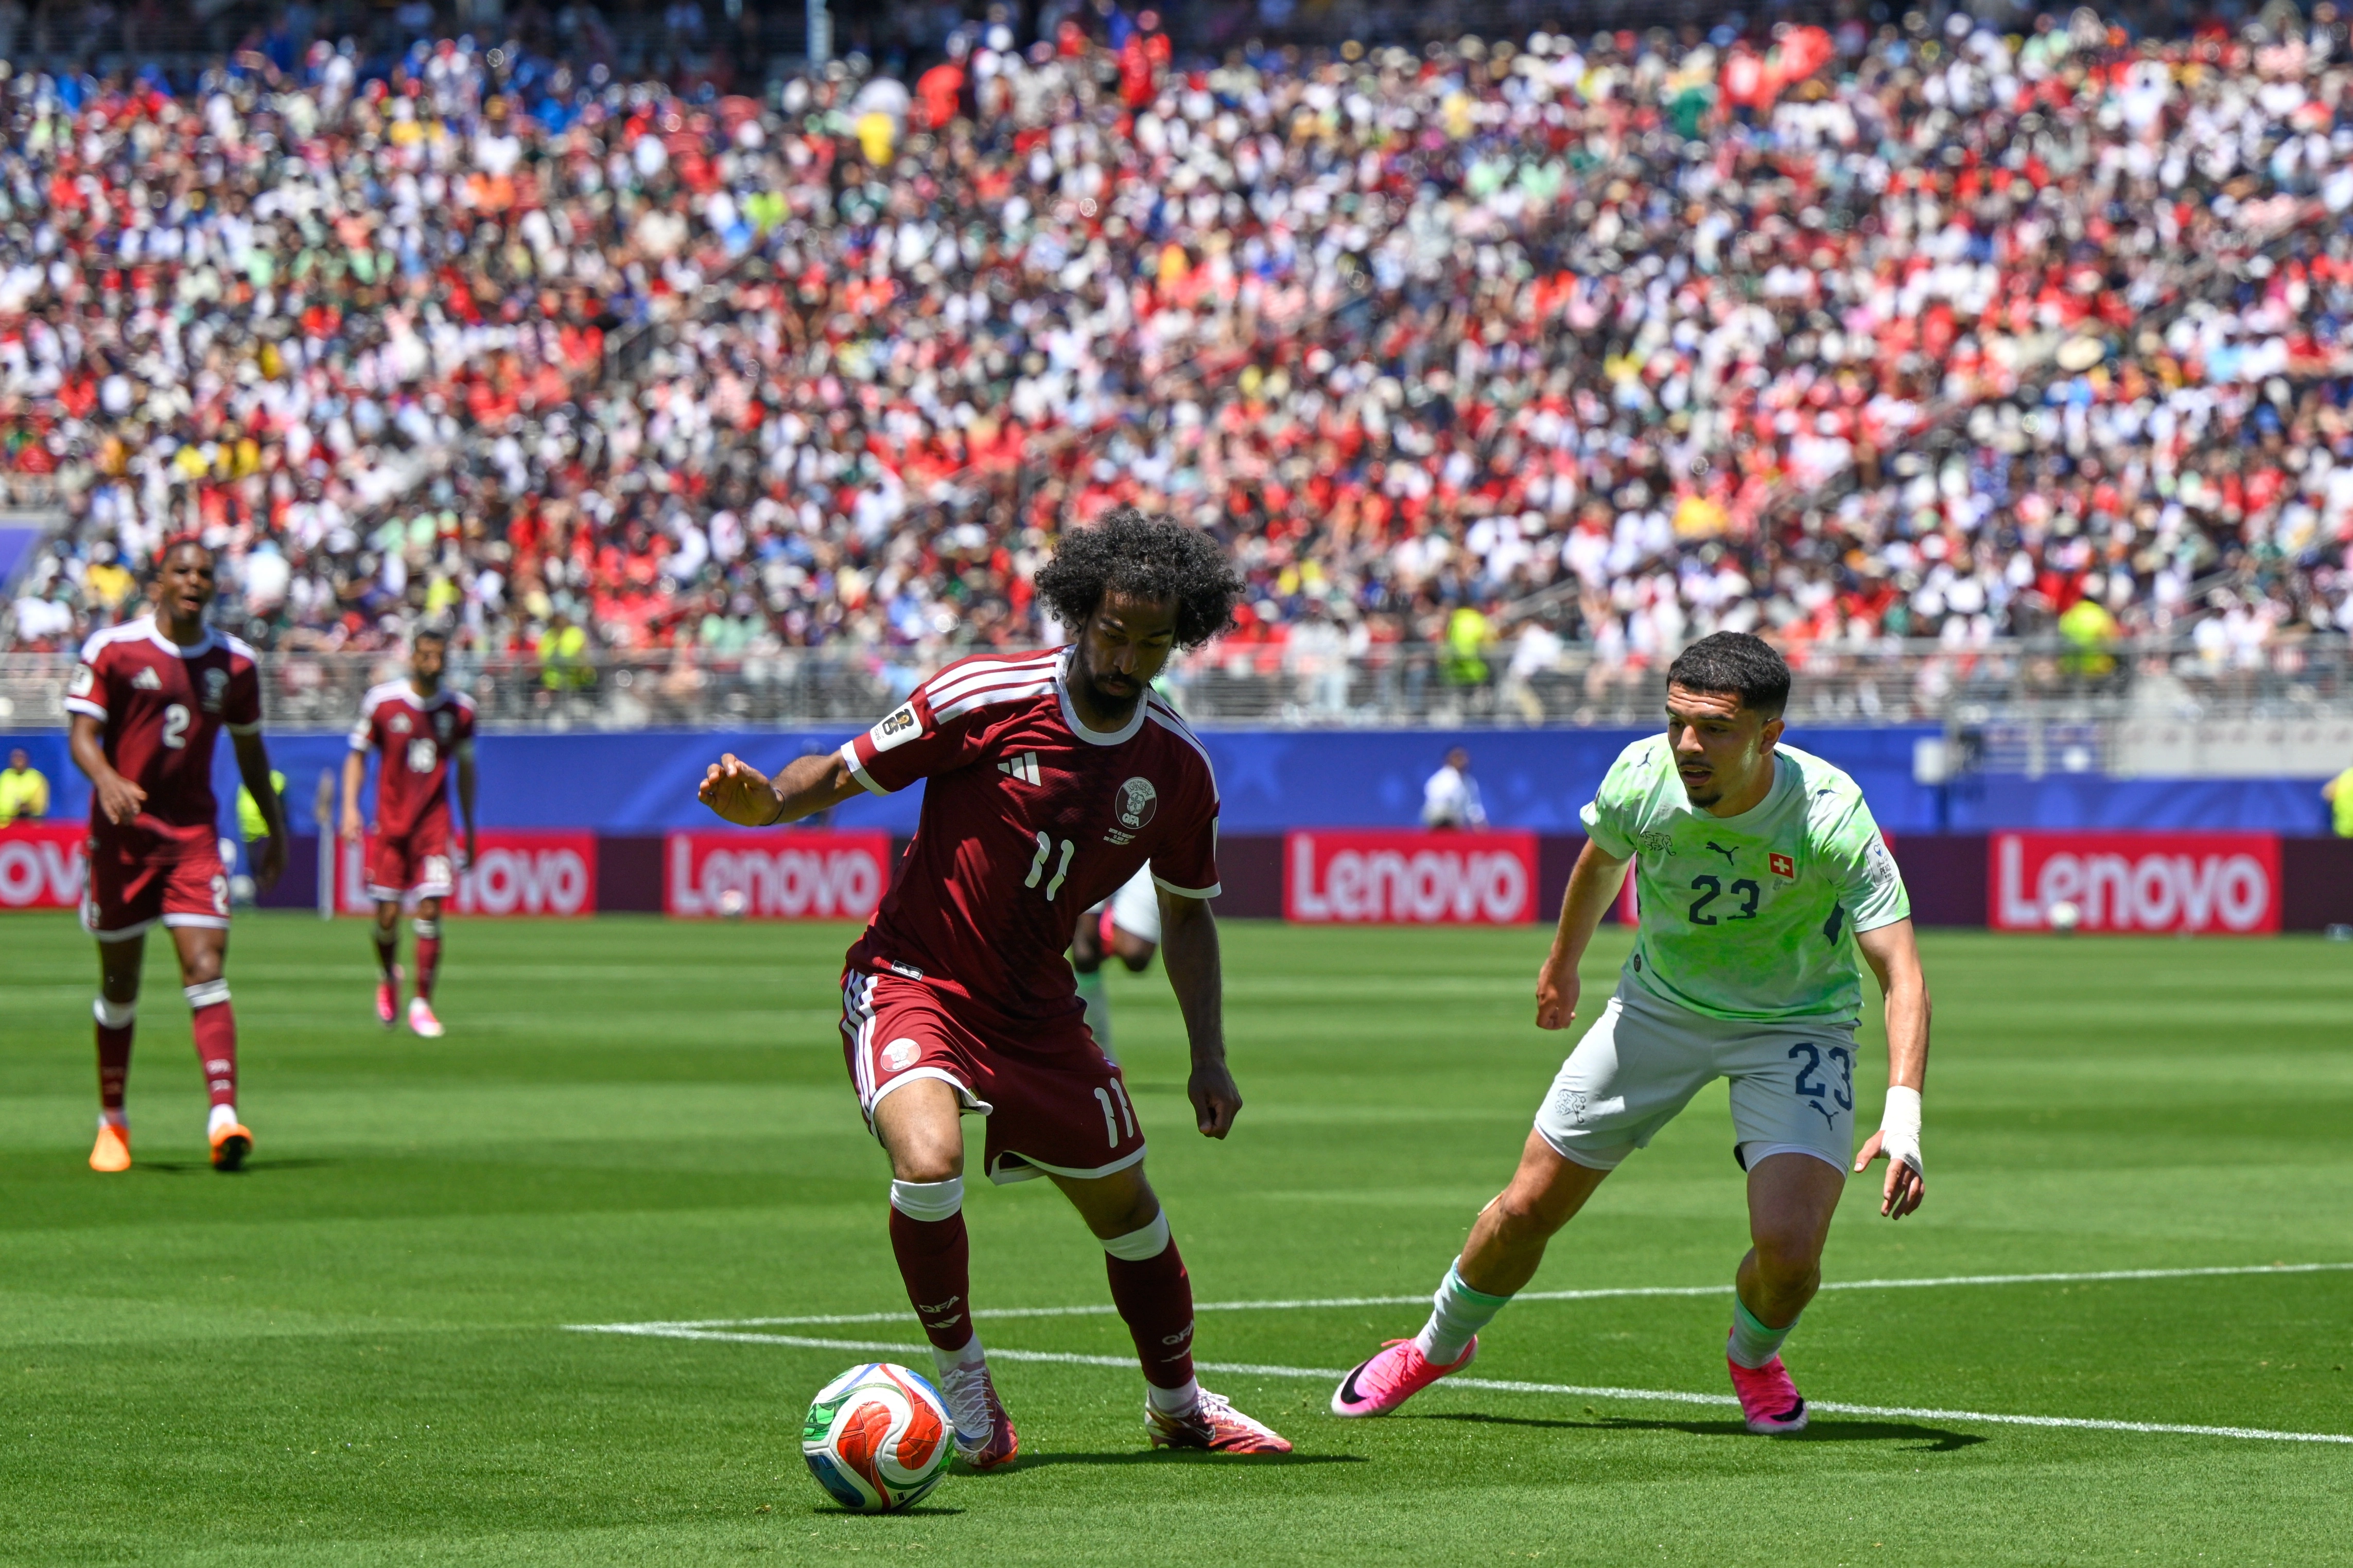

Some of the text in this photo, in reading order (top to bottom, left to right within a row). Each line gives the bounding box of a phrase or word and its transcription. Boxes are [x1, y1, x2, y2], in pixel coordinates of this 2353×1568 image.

[162, 703, 190, 749] 2
[1122, 813, 1139, 827] QFA
[210, 874, 230, 915] 2
[671, 833, 882, 918] Lenovo
[1024, 831, 1074, 901] 11
[1292, 831, 1528, 923] Lenovo
[1998, 832, 2270, 932] Lenovo
[1689, 875, 1760, 925] 23
[1788, 1043, 1852, 1111] 23
[1094, 1077, 1134, 1148] 11
[919, 1295, 960, 1313] QFA
[1162, 1319, 1194, 1345] QFA
